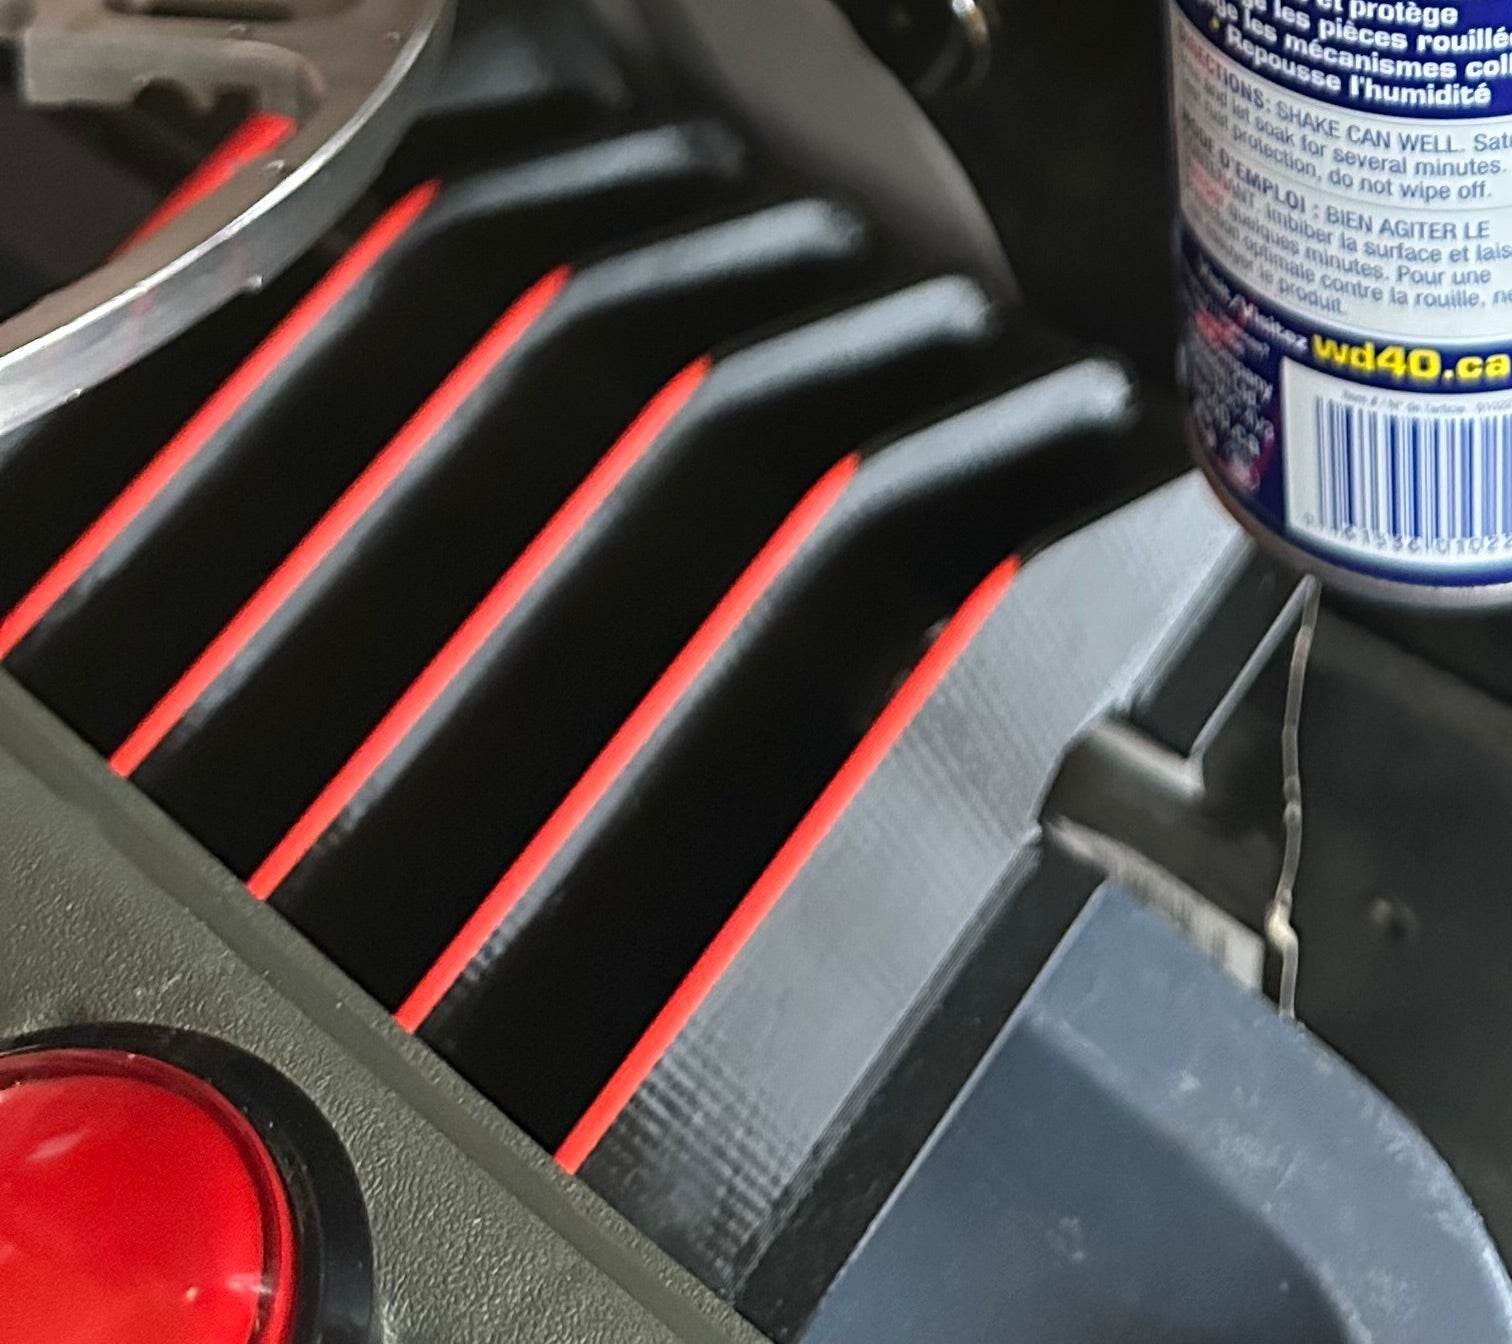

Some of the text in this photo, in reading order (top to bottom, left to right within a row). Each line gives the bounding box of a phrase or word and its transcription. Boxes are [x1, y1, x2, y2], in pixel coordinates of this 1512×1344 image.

[1225, 23, 1342, 92] Repousse
[1350, 74, 1492, 106] l'humidité
[1243, 9, 1278, 43] les
[1284, 32, 1457, 80] mécanismes
[1254, 118, 1296, 148] soak
[1301, 133, 1327, 158] for
[1333, 146, 1407, 174] several
[1414, 157, 1507, 177] minutes.
[1276, 100, 1341, 140] SHAKE
[1347, 125, 1391, 148] CAN
[1399, 132, 1465, 154] WELL.
[1328, 167, 1354, 188] do
[1359, 172, 1393, 197] not
[1399, 181, 1451, 204] wipe
[1457, 179, 1493, 200] off.
[1326, 204, 1374, 233] BIEN
[1378, 218, 1457, 241] AGITER
[1463, 219, 1491, 240] LE
[1305, 246, 1391, 282] minutes.
[1396, 265, 1445, 286] Pour
[1452, 268, 1492, 286] une
[1339, 228, 1358, 253] la
[1363, 243, 1442, 264] surface
[1449, 245, 1469, 263] et
[1321, 273, 1384, 302] contre
[1389, 287, 1409, 306] la
[1415, 290, 1487, 310] rouille,
[1312, 333, 1512, 383] wd40.ca
